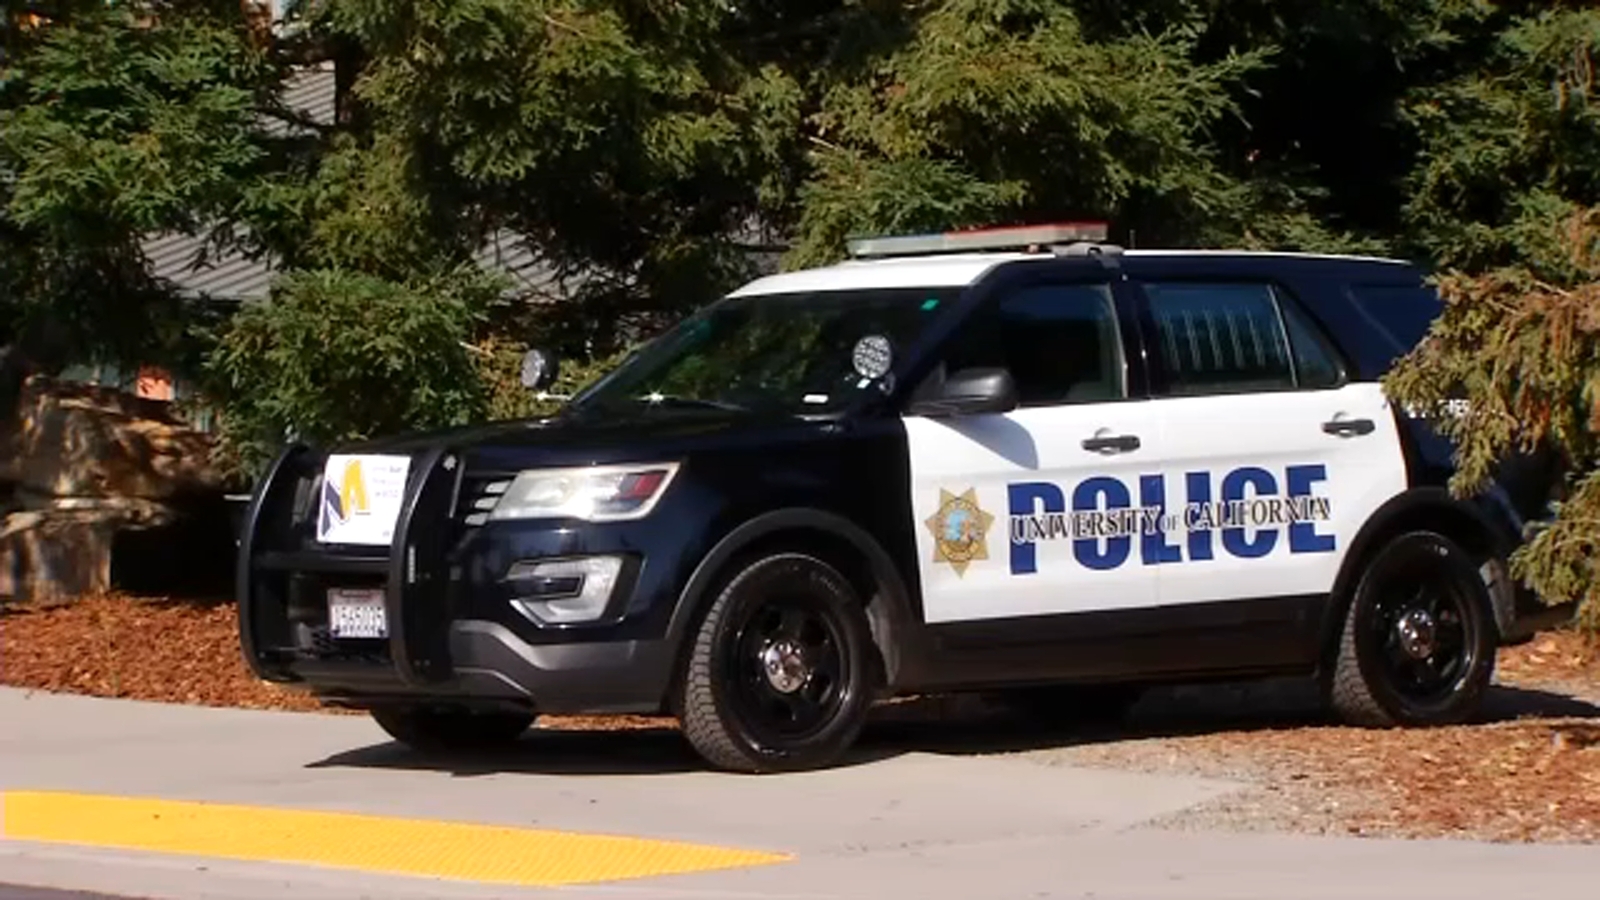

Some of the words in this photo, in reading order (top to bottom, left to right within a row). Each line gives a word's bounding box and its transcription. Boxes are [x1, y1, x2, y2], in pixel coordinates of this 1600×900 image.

[1007, 464, 1336, 575] POLICE
[1009, 504, 1162, 543] UNIVERSITY
[1184, 495, 1331, 530] CALIFORNIA
